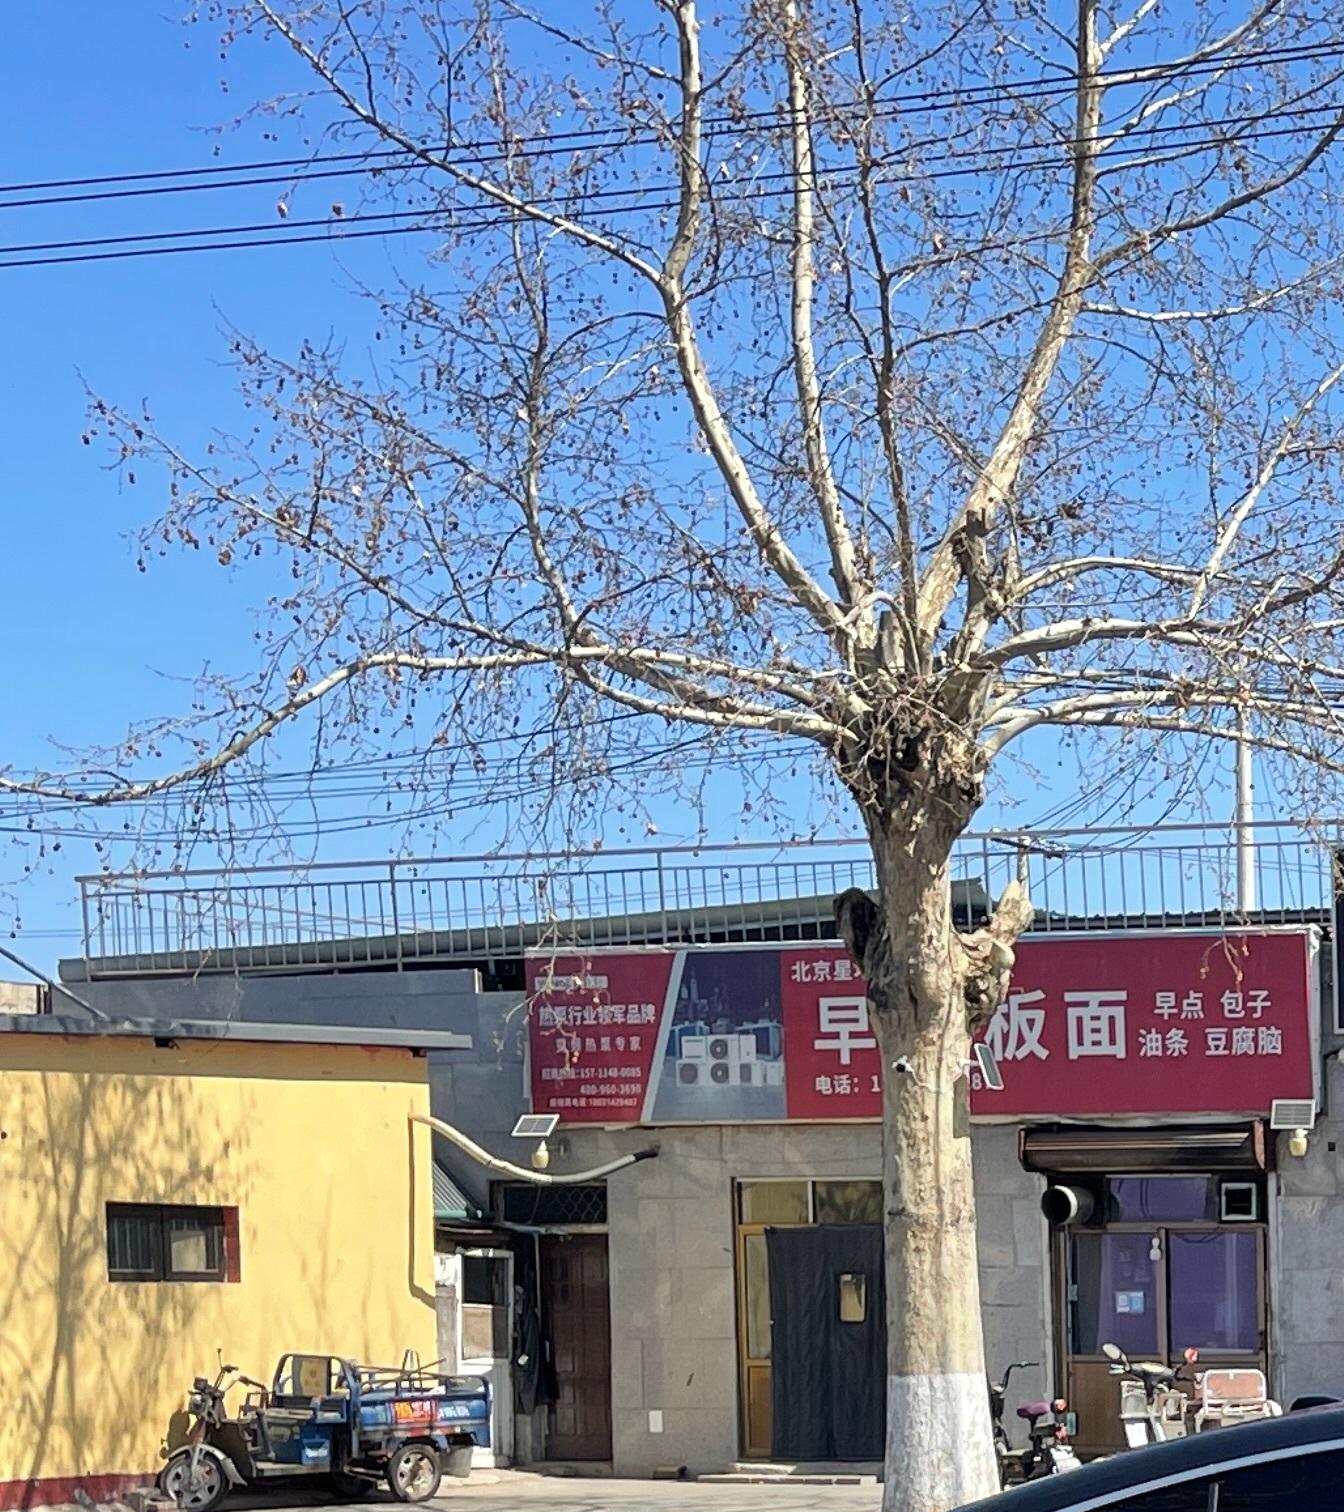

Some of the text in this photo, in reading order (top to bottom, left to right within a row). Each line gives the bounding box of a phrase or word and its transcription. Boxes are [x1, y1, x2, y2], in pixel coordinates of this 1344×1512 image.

[1153, 989, 1272, 1020] 早点 包子
[1138, 1026, 1283, 1057] 油条 豆腐脑
